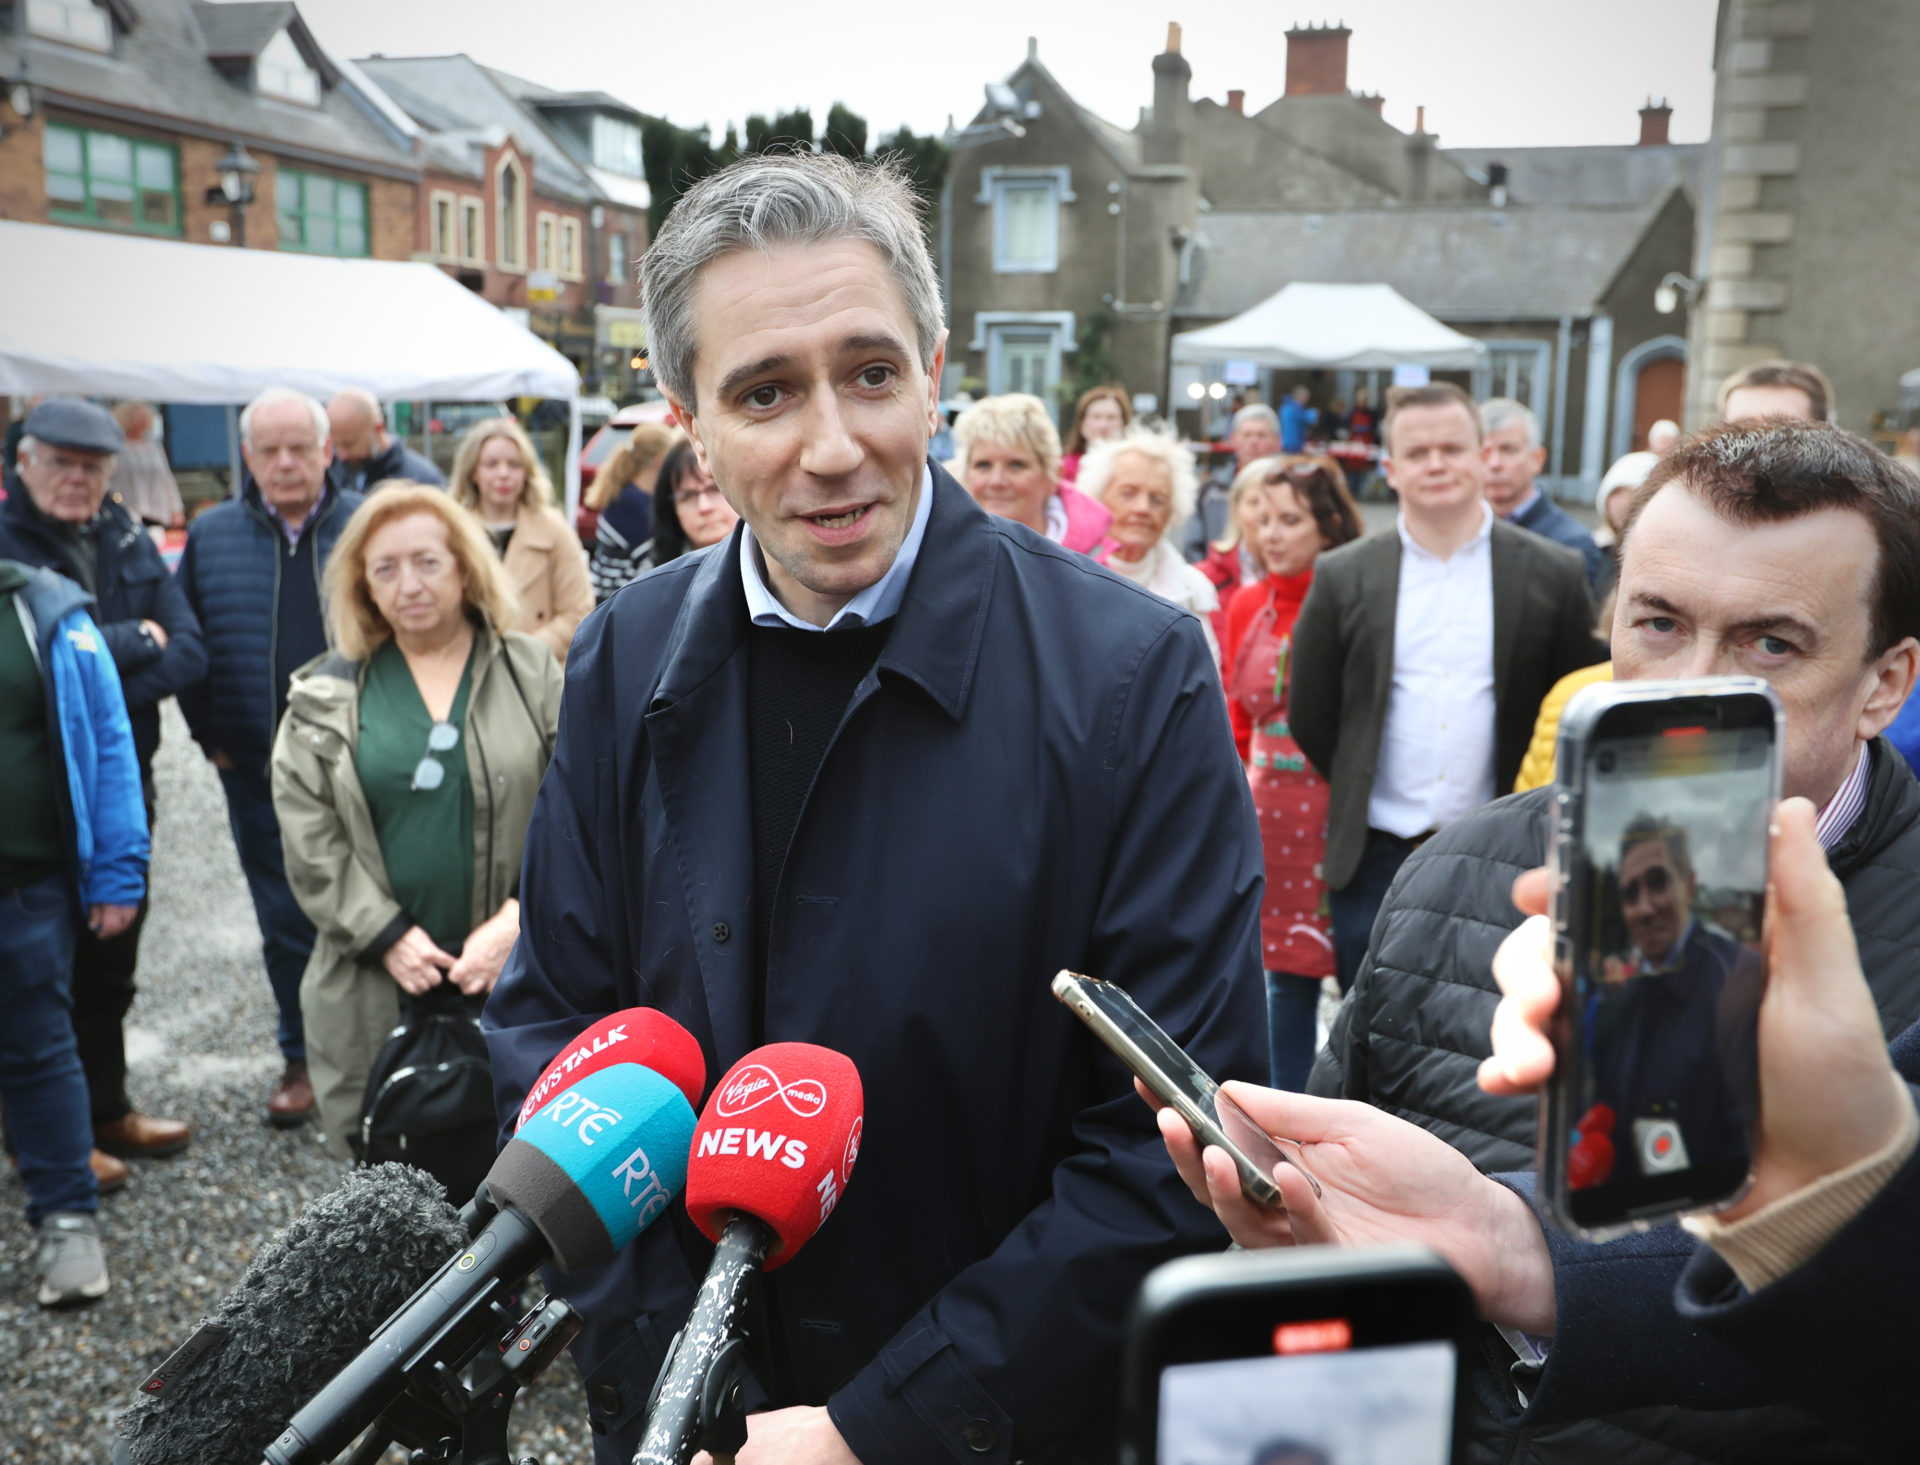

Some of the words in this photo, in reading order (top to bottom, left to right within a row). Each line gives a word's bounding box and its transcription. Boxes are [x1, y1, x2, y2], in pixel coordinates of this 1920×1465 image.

[726, 1073, 770, 1105] Virgin
[787, 1088, 821, 1105] media
[541, 1091, 623, 1146] RTÉ
[697, 1128, 808, 1169] NEWS
[157, 1347, 197, 1382] Rycote
